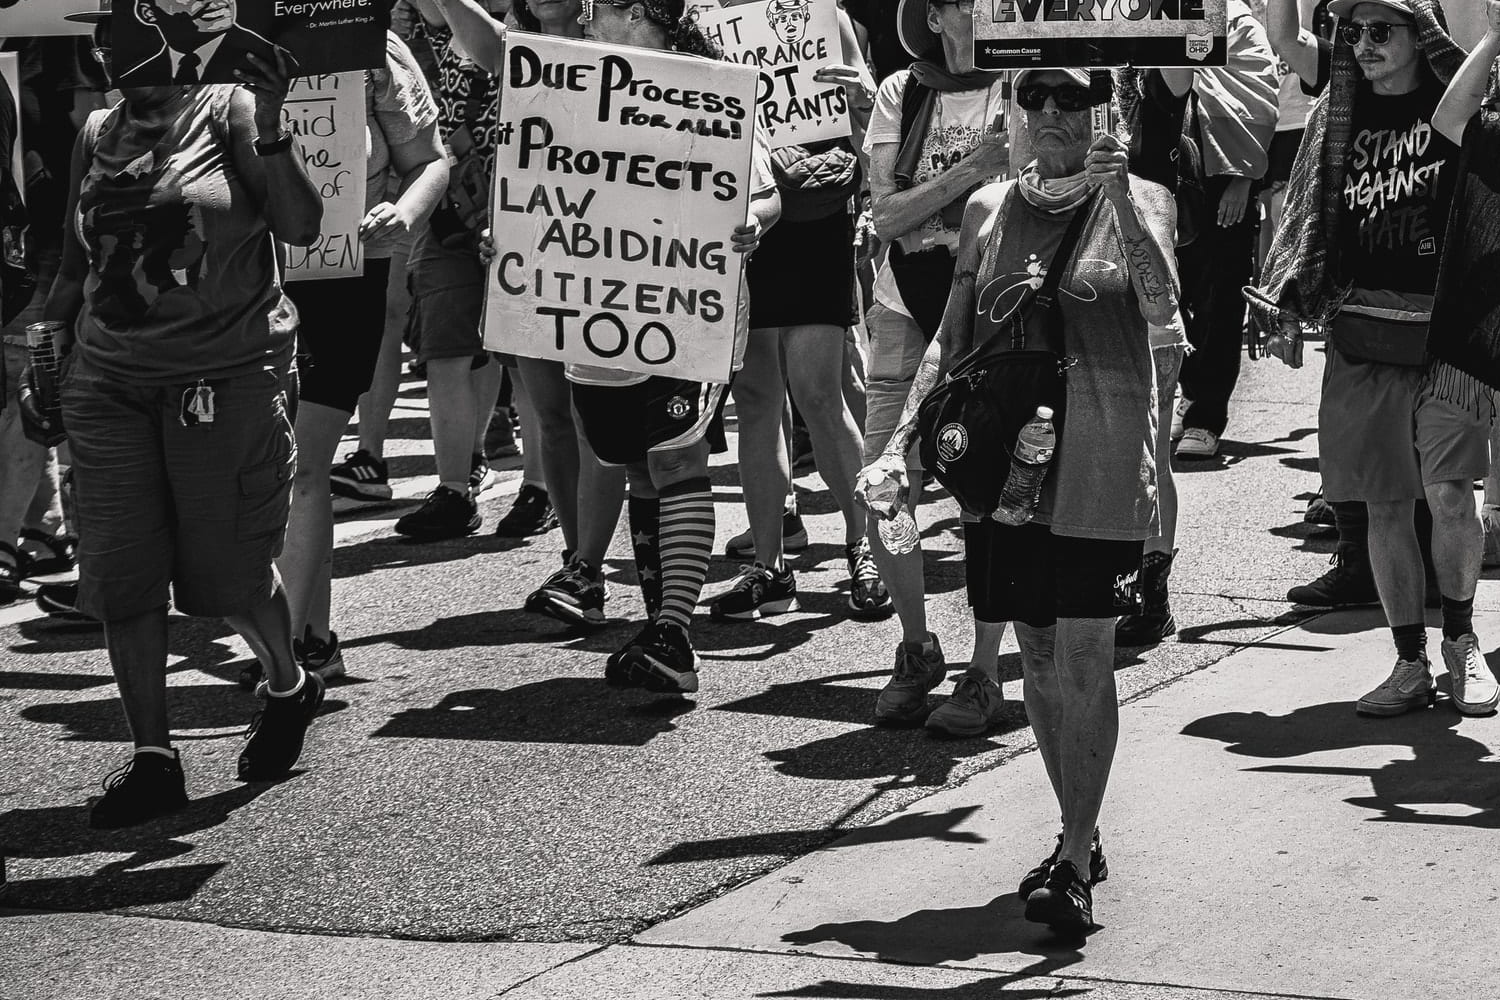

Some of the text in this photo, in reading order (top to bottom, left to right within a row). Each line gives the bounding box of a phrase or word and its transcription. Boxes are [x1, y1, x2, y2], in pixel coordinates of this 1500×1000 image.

[677, 119, 742, 140] ALL!
[1353, 117, 1432, 171] STAND
[320, 171, 351, 199] of
[517, 116, 739, 202] PROTECTS
[1343, 159, 1447, 211] AGAINST
[499, 178, 596, 219] LAW
[1359, 205, 1432, 254] HATE
[497, 252, 724, 324] CITIZENS
[536, 306, 677, 365] TOO
